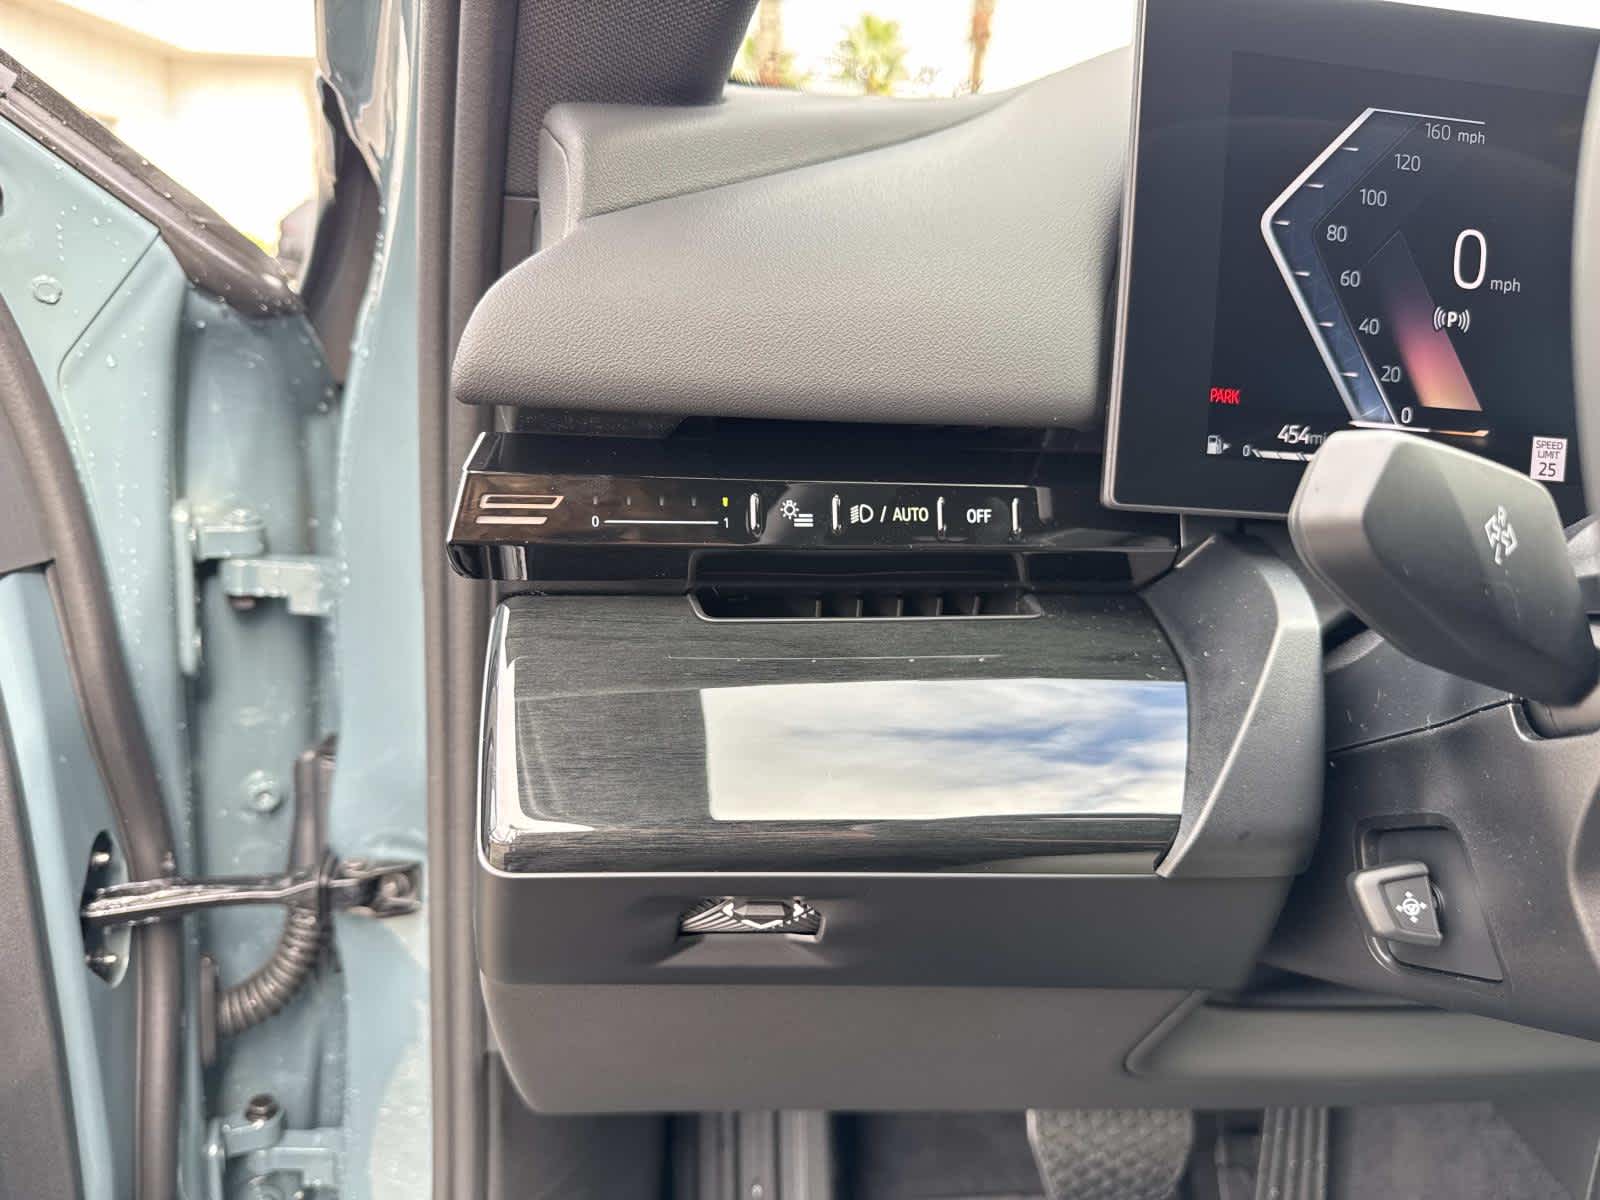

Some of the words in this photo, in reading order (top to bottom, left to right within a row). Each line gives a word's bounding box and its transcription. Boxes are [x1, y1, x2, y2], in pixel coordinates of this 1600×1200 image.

[1424, 122, 1451, 141] 160
[1457, 131, 1486, 147] mph
[1393, 153, 1421, 172] 120
[1359, 188, 1388, 207] 100
[1326, 224, 1348, 242] 80
[1453, 228, 1487, 290] 0
[1490, 278, 1521, 295] mph
[1339, 270, 1361, 288] 60
[1358, 318, 1380, 335] 40
[1380, 365, 1401, 383] 20
[1209, 387, 1240, 404] PARK
[1401, 407, 1412, 424] 0
[1242, 444, 1251, 457] 0
[1535, 439, 1564, 451] SPEED
[1537, 450, 1561, 461] LIMIT
[1538, 462, 1556, 478] 25
[591, 515, 599, 529] 0
[723, 517, 729, 529] 1
[892, 506, 930, 522] AUTO
[966, 508, 992, 525] OFF
